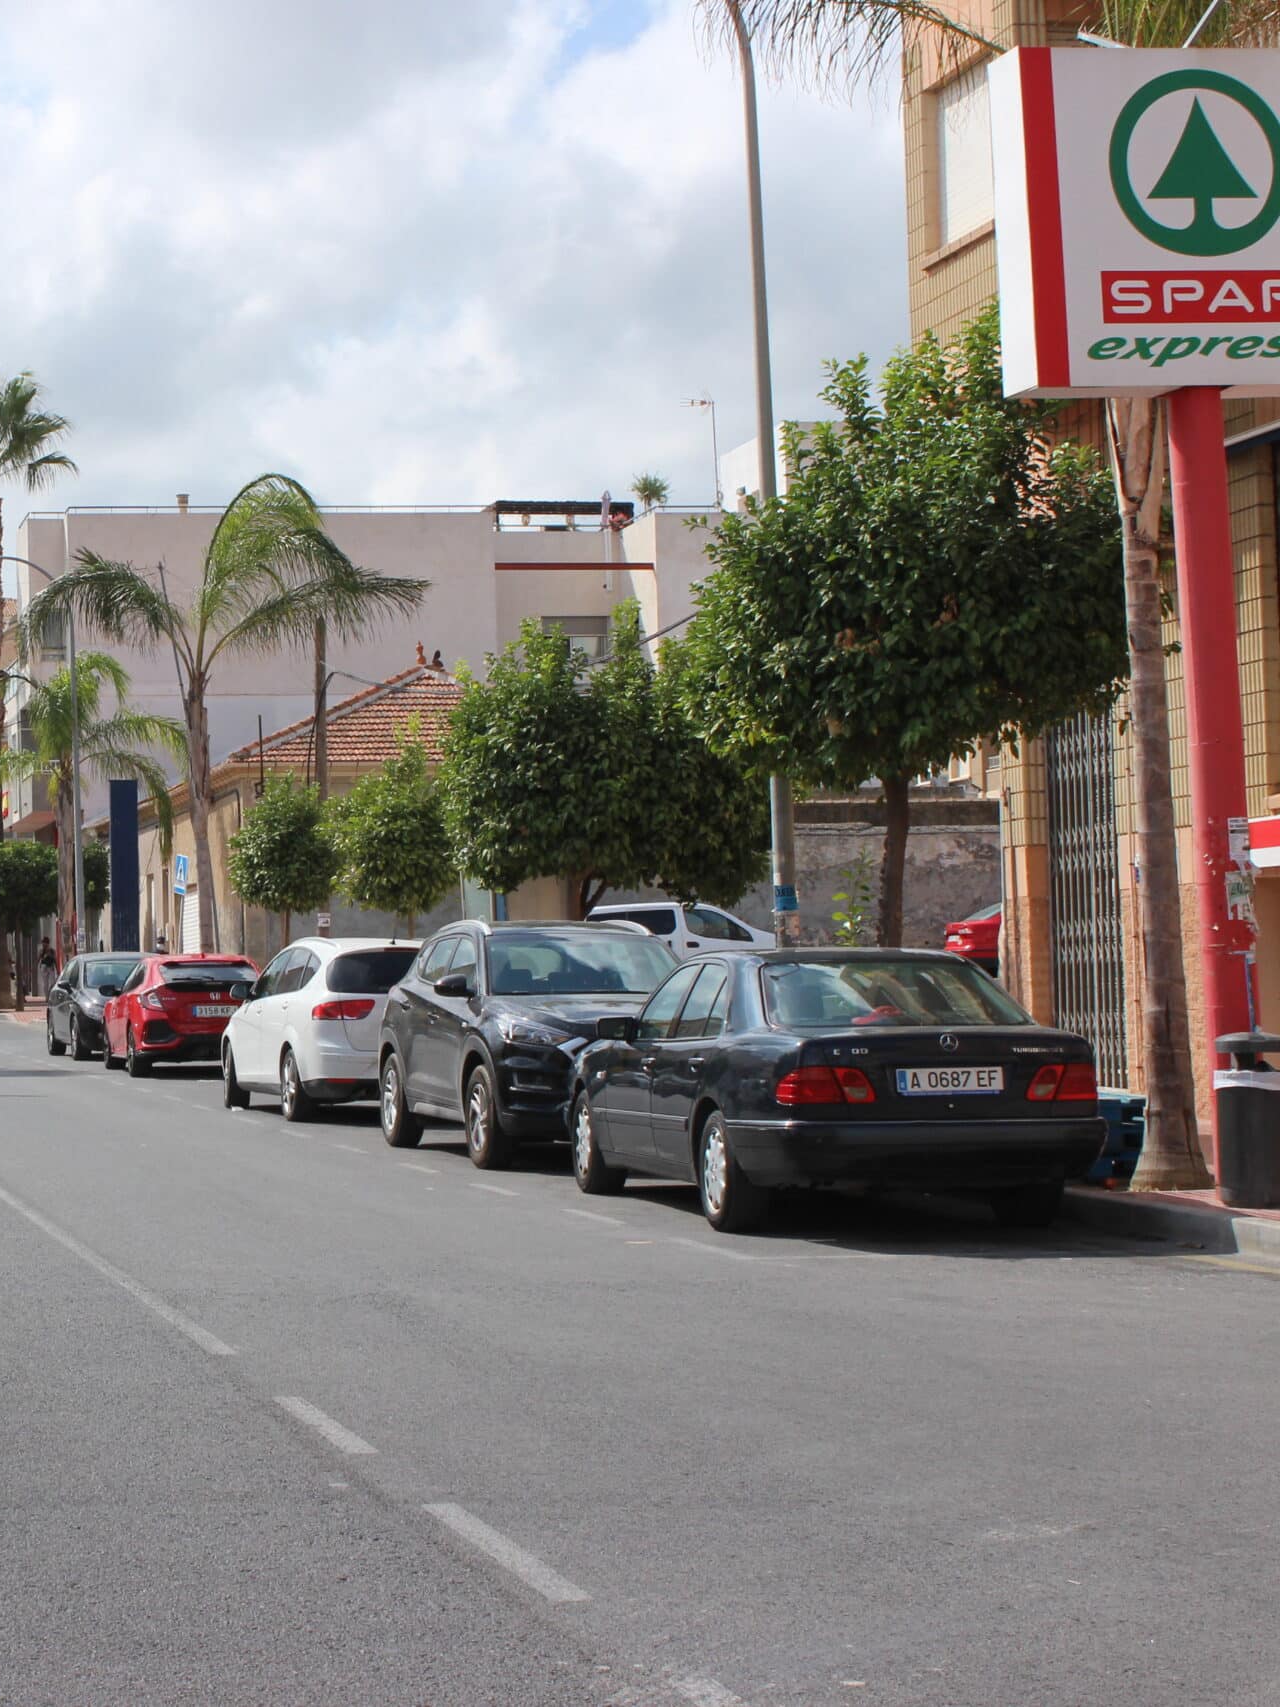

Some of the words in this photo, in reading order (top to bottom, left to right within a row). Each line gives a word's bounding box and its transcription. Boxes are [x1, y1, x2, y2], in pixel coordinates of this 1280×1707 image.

[910, 1071, 921, 1089] A
[927, 1070, 971, 1088] 0687
[976, 1069, 998, 1088] EF
